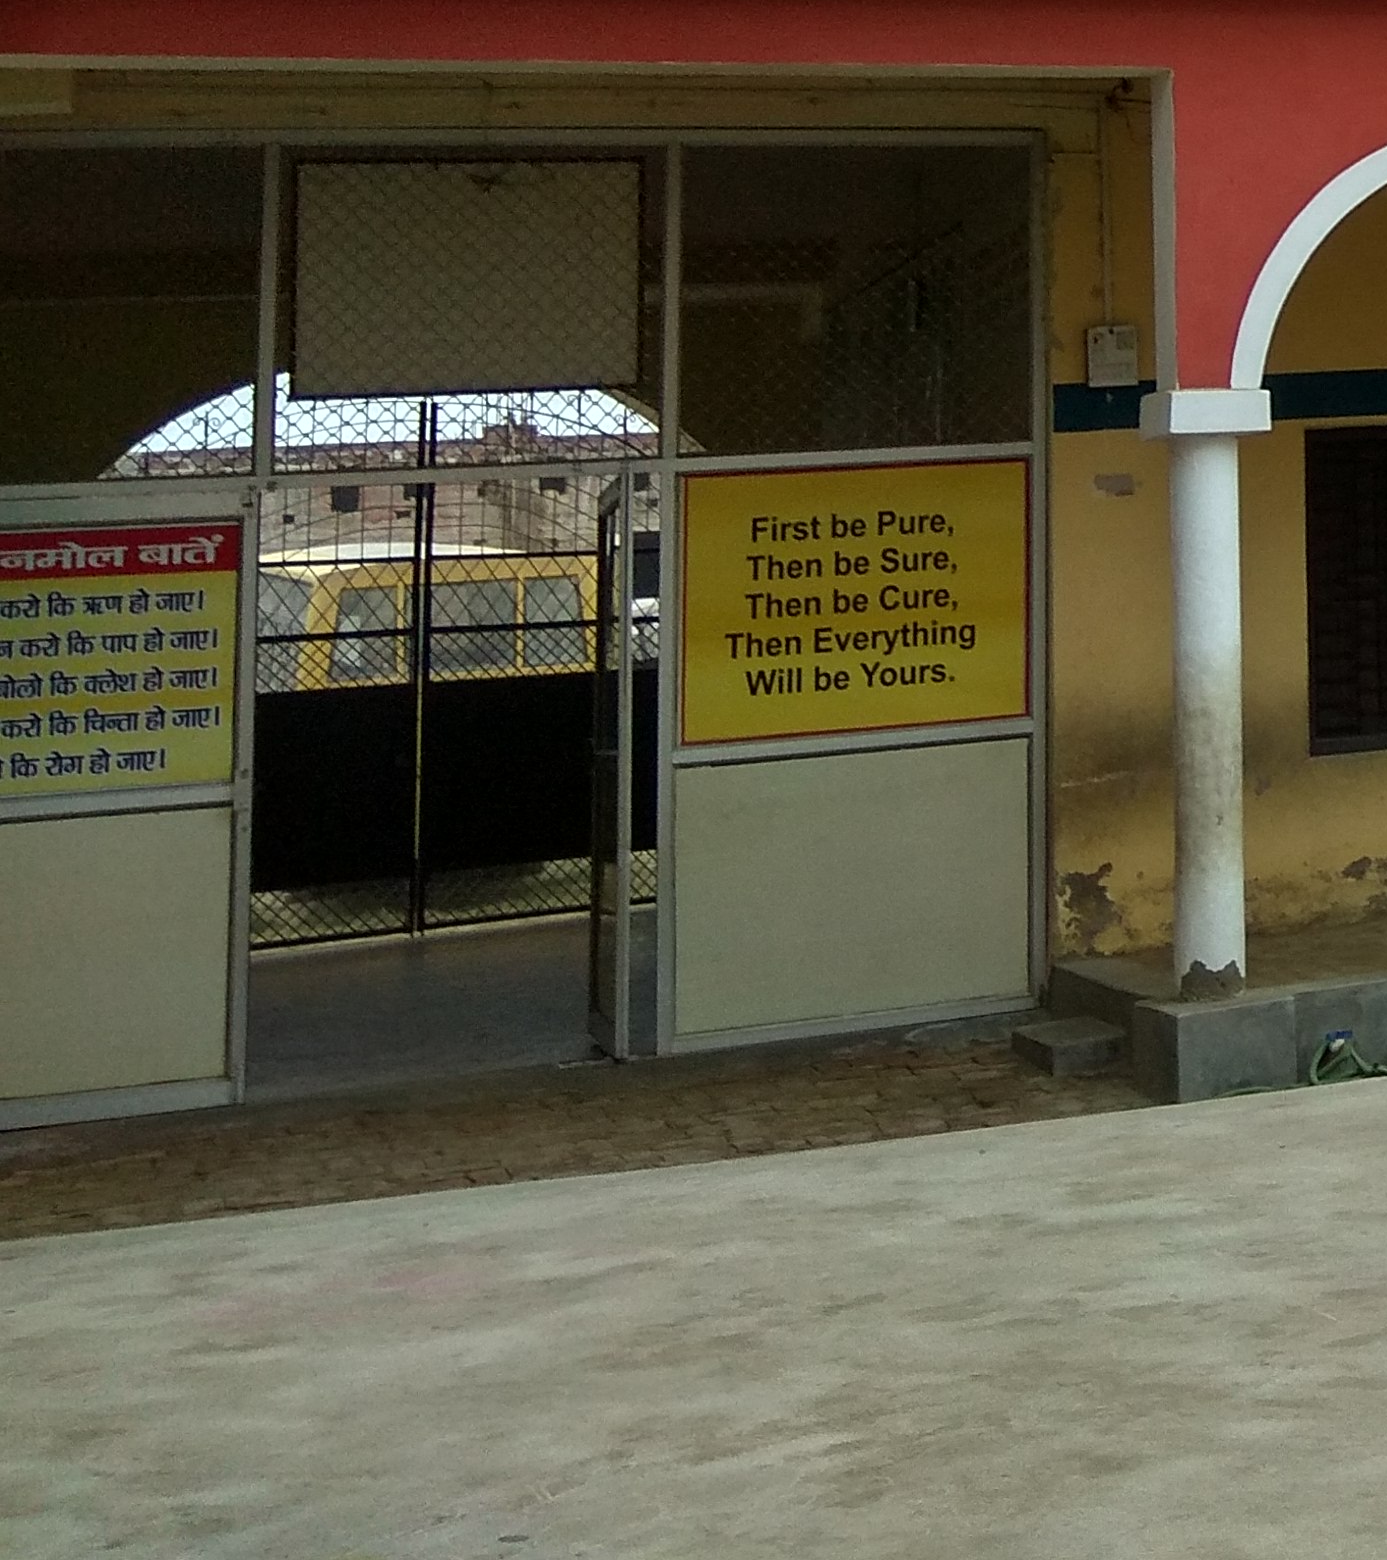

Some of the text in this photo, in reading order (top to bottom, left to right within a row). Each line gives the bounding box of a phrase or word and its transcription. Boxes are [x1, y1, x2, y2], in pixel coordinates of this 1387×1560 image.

[752, 510, 953, 542] First be Pure,
[138, 534, 224, 565] बातें
[747, 547, 957, 580] Then be Sure,
[0, 593, 40, 618] करो
[48, 591, 76, 617] कि
[82, 595, 123, 615] ऋण
[129, 588, 150, 614] हो
[746, 585, 957, 619] Then be Cure,
[20, 632, 60, 657] करो
[67, 630, 96, 655] कि
[102, 634, 138, 653] पाप
[144, 627, 165, 652] हो
[725, 620, 975, 659] Then Everything
[50, 671, 78, 696] कि
[84, 668, 137, 694] क्लेश
[143, 666, 164, 692] हो
[746, 661, 954, 696] Will be Yours.
[1, 712, 42, 738] करो
[49, 710, 79, 735] कि
[84, 708, 138, 733] चिन्ता
[145, 705, 166, 731] हो
[10, 752, 40, 778] कि
[45, 751, 84, 776] रोग
[89, 748, 111, 774] हो
